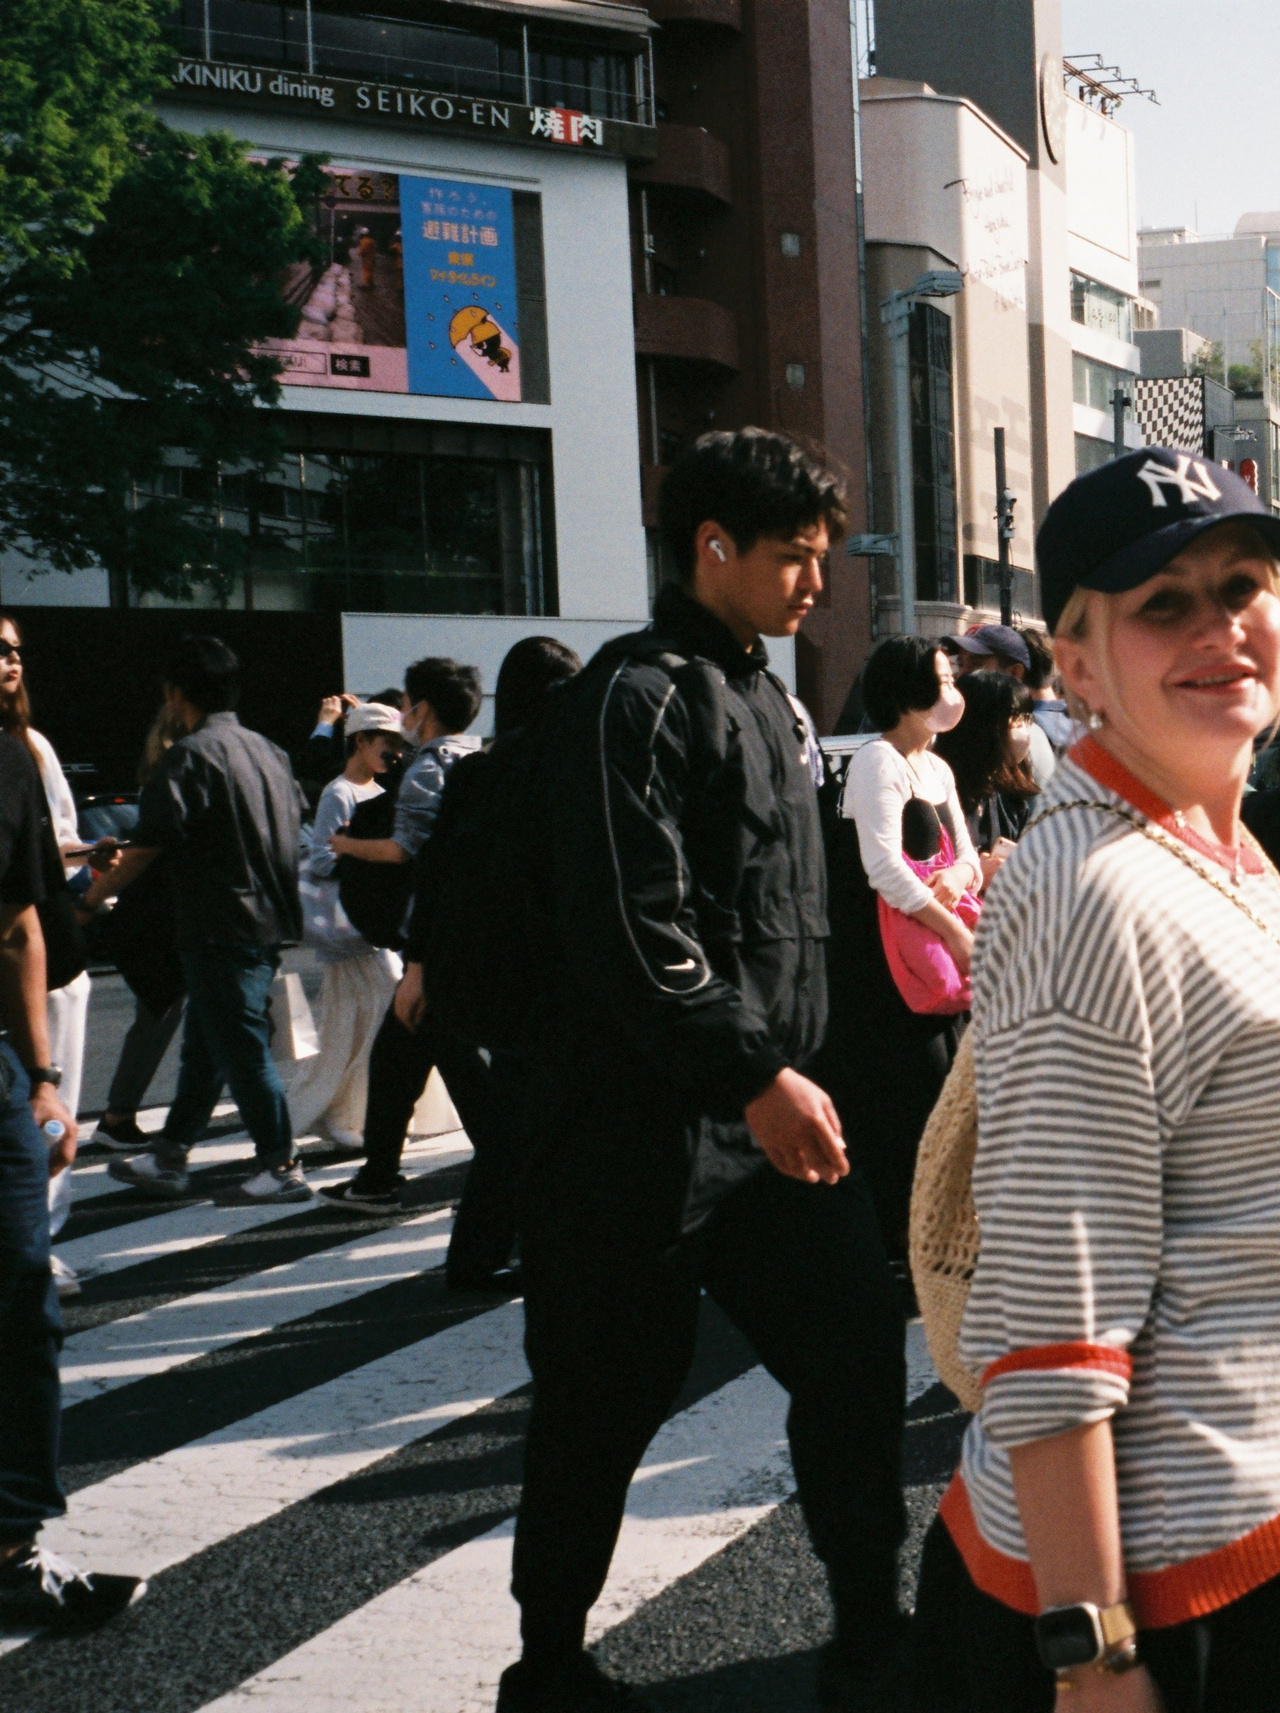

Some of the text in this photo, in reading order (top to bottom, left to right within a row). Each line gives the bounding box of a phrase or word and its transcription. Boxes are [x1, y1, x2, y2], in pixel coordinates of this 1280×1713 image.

[172, 62, 510, 129] KINIKU dining SEIKO-EN
[529, 106, 603, 146] 焼肉
[422, 220, 498, 247] 避難計画
